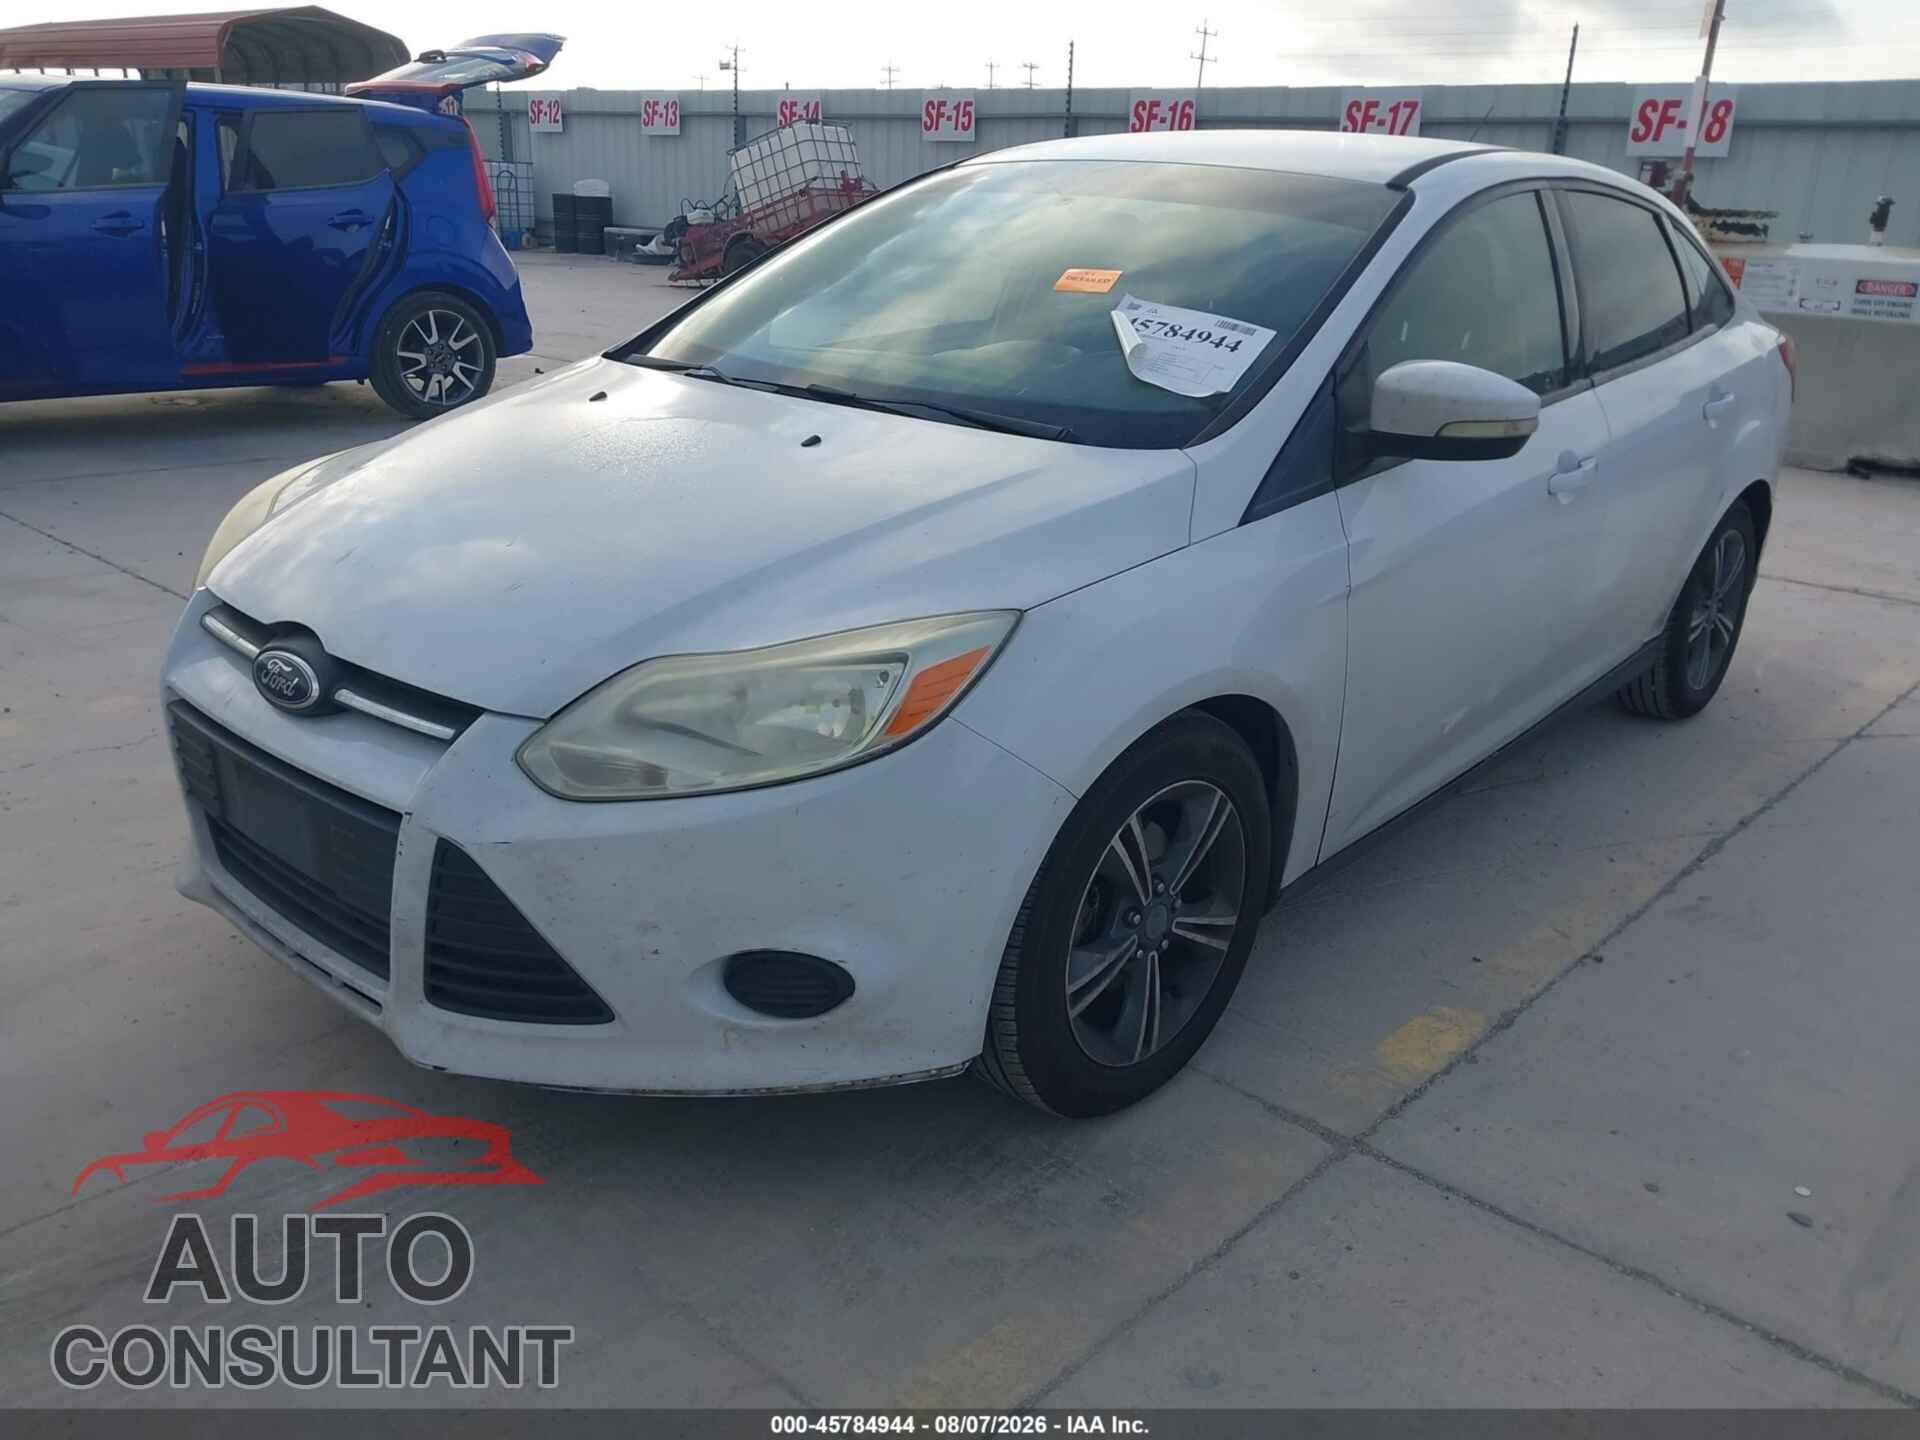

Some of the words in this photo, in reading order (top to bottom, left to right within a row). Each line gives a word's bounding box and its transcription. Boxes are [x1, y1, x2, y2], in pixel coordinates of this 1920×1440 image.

[530, 100, 560, 124] SF-12
[642, 100, 678, 127] SF-13
[779, 101, 820, 126] SF-14
[923, 100, 974, 132] SF-15
[1131, 100, 1193, 132] SF-16
[1342, 101, 1418, 135] SF-17
[1631, 99, 1734, 143] SF-8
[262, 659, 299, 696] Ford
